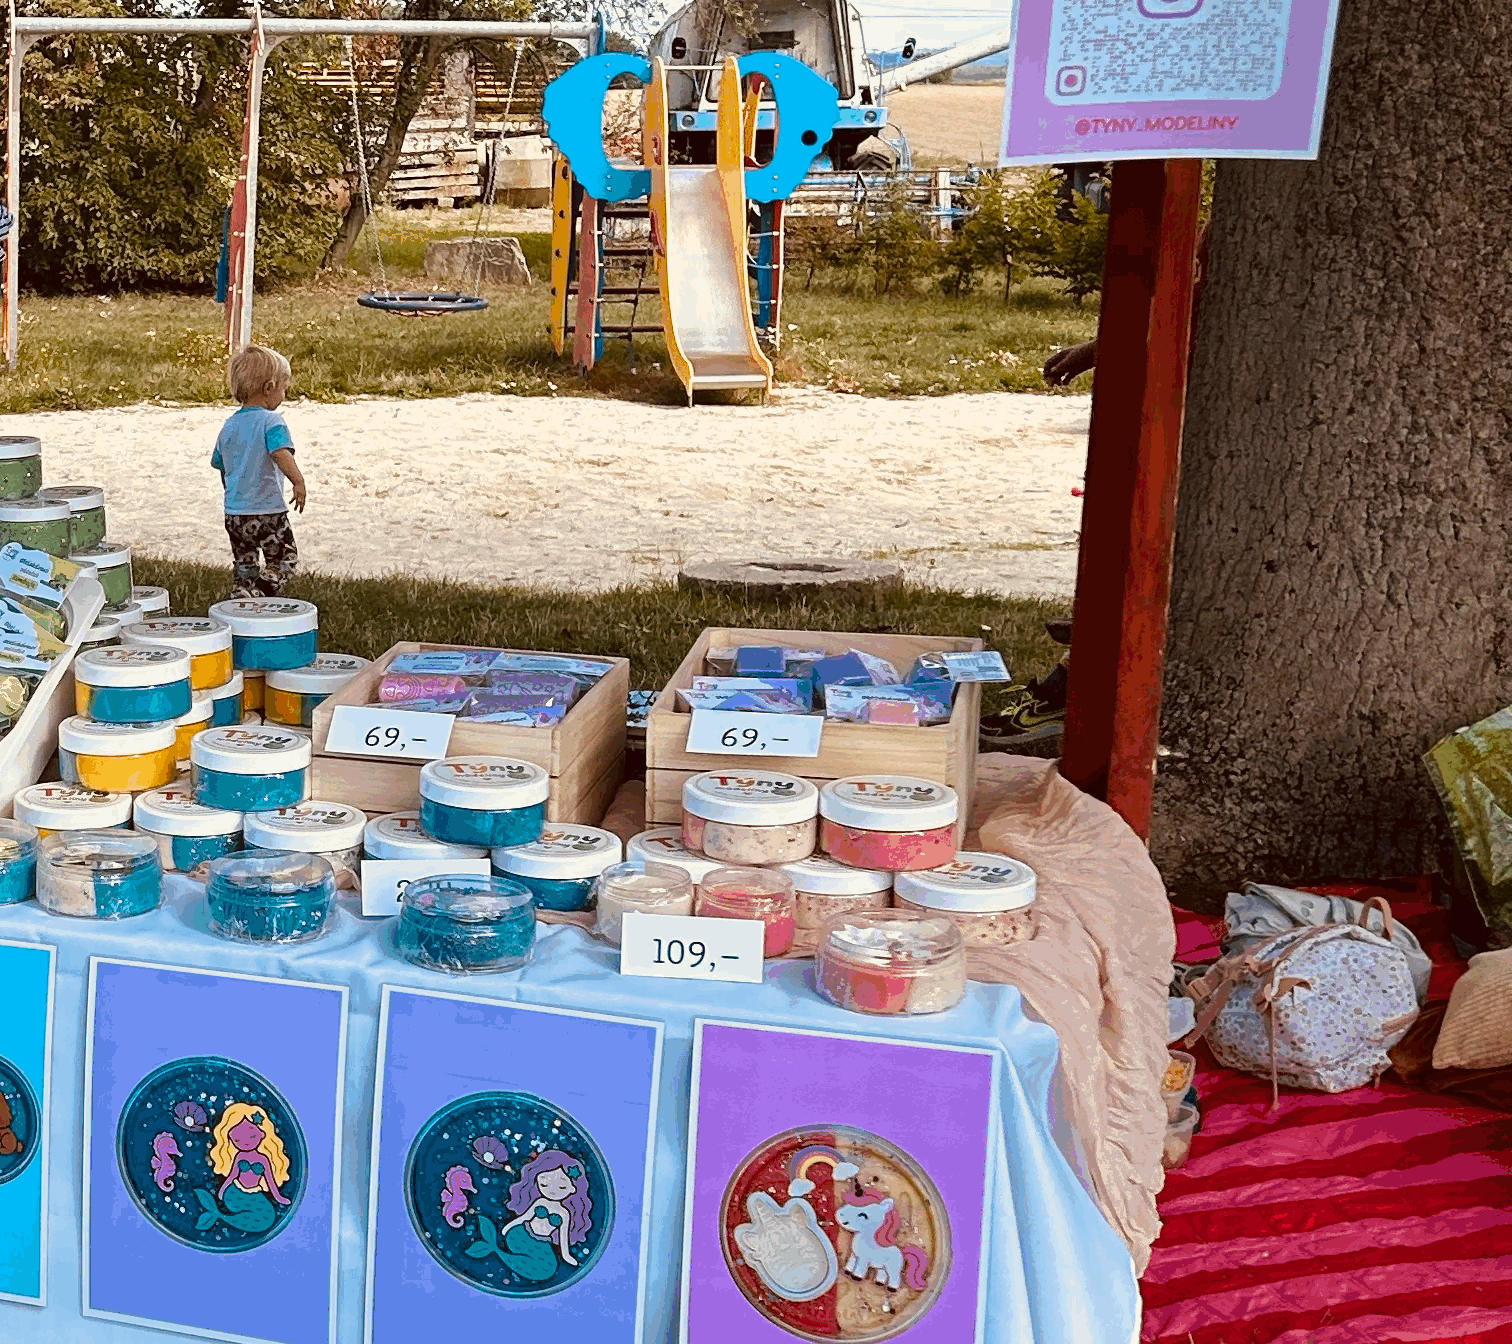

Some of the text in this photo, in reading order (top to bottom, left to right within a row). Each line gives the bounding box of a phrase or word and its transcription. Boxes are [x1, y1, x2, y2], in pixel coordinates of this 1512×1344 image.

[364, 726, 427, 751] 69,-
[720, 727, 789, 751] 69,-
[652, 937, 740, 972] 109,-
